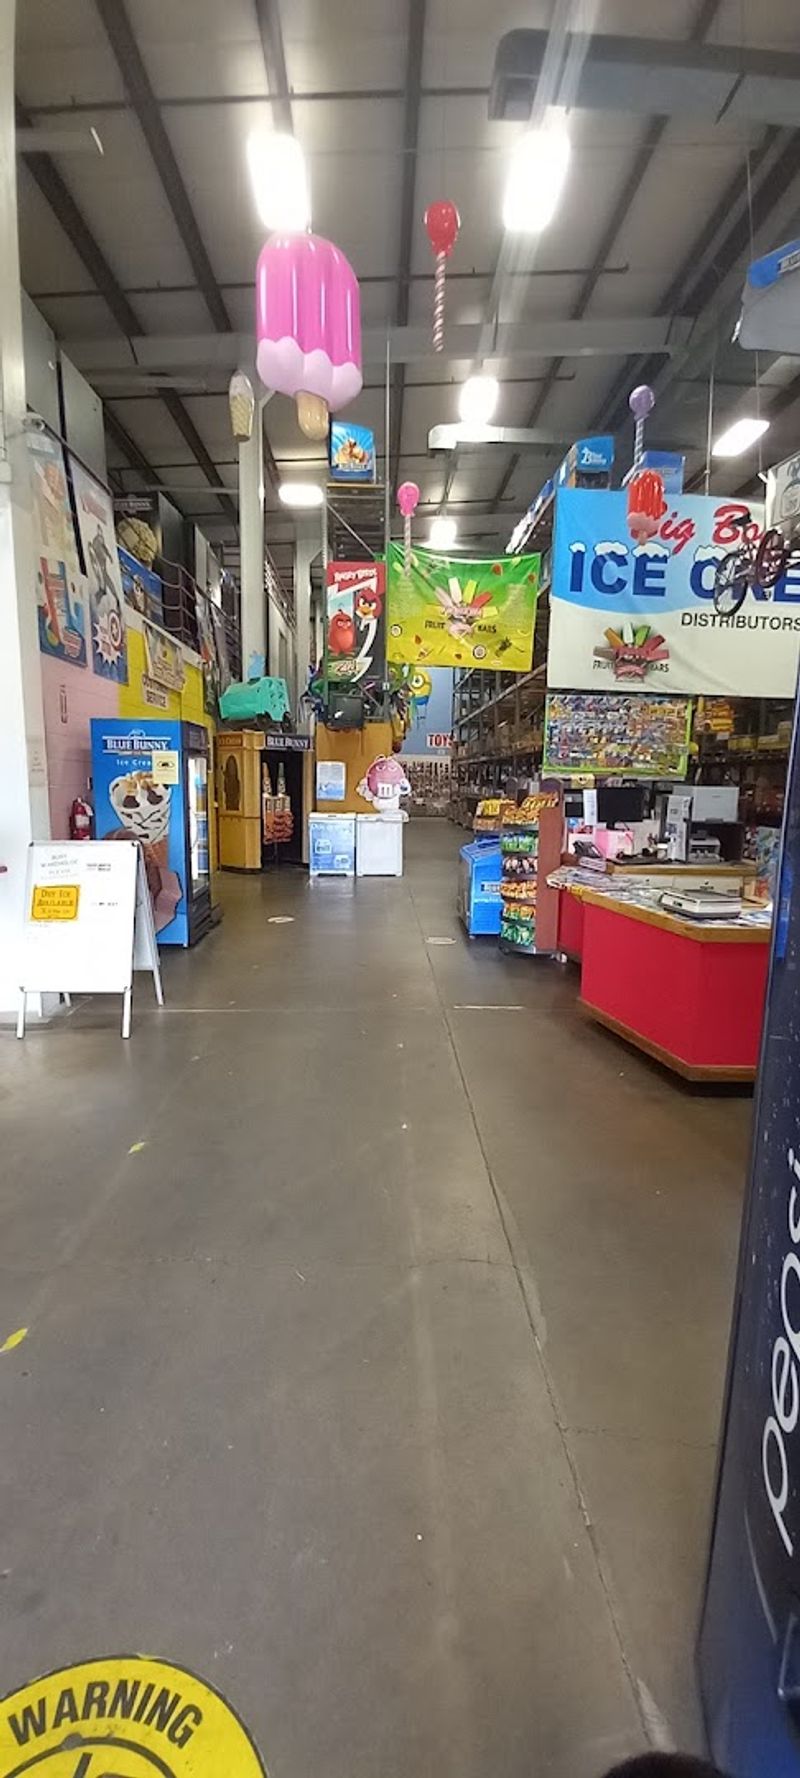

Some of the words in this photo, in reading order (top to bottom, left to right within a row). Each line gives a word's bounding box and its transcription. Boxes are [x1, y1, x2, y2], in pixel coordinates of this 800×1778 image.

[569, 543, 670, 597] ICE
[425, 620, 446, 629] FRUIT
[681, 612, 800, 632] DISTRIBUTORS
[106, 738, 132, 750] BLUE
[133, 738, 168, 750] BUNNY
[266, 735, 284, 747] BLUE
[285, 737, 309, 749] BUNNY
[116, 759, 128, 767] Ice
[132, 759, 151, 767] Crea
[8, 1679, 204, 1750] WARNING
